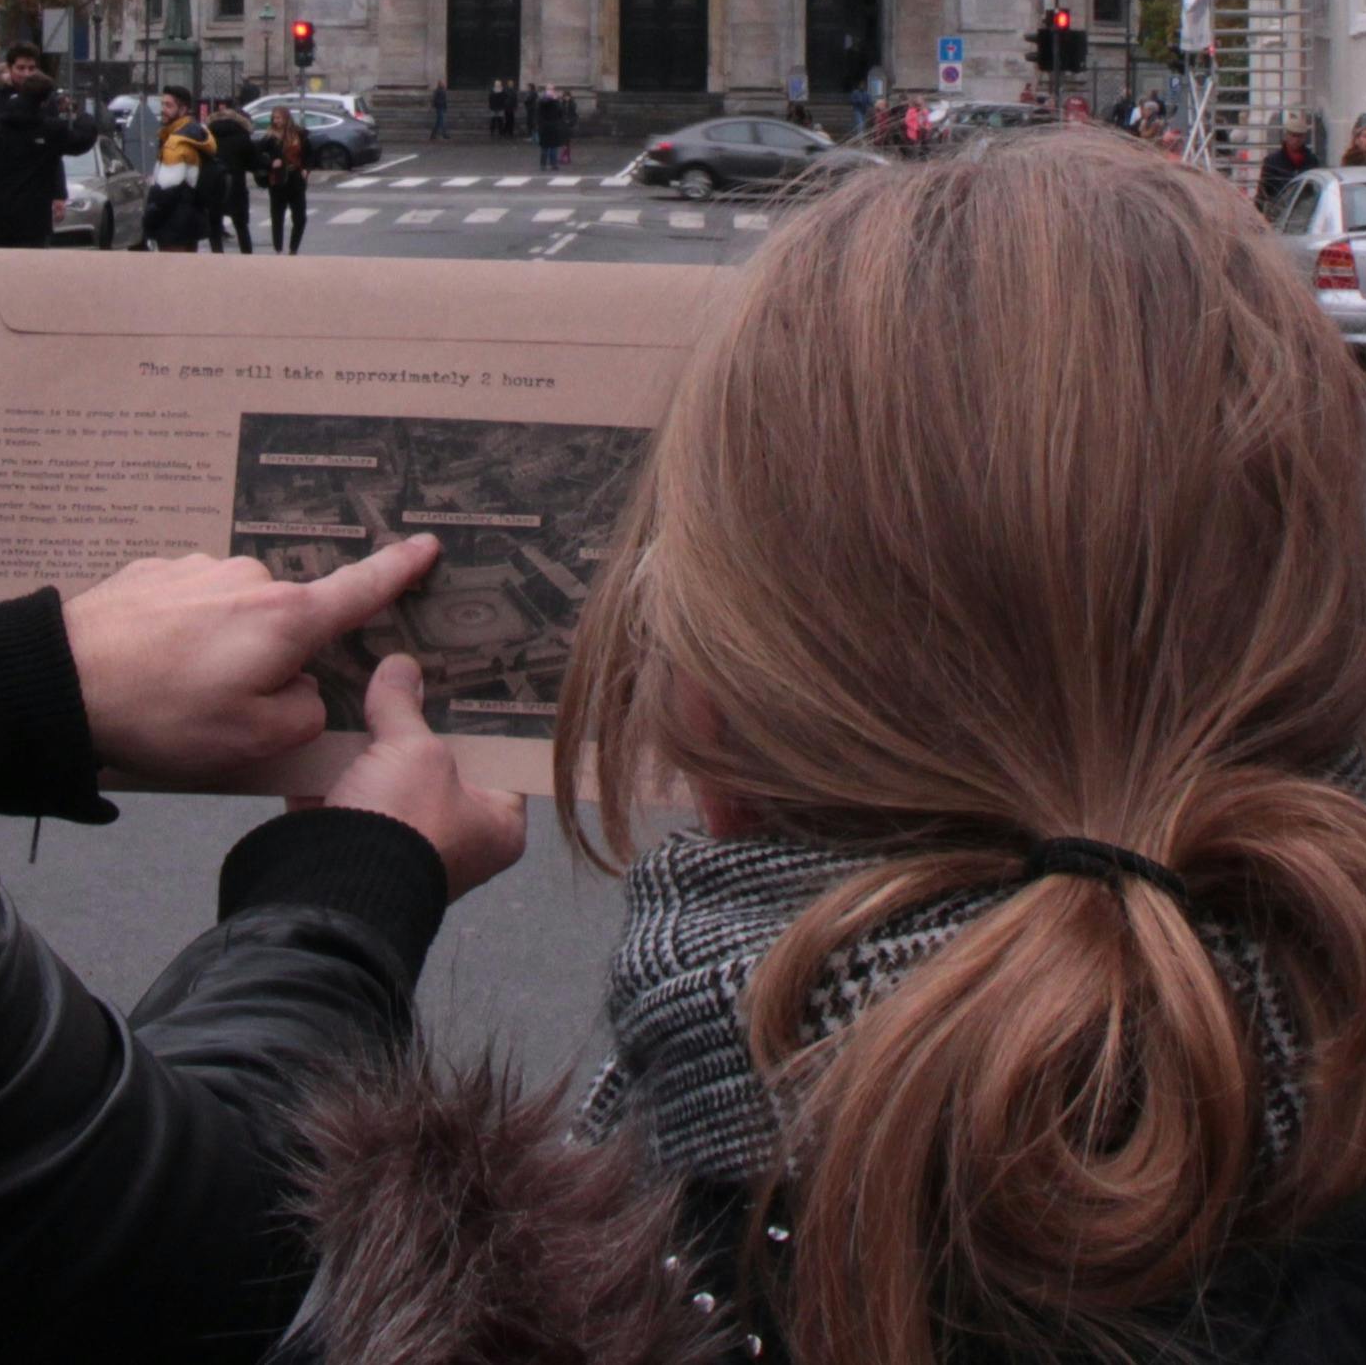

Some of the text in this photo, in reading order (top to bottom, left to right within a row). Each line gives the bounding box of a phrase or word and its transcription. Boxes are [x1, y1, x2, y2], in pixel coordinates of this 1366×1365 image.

[139, 362, 555, 388] The game will take approximately 2 hours
